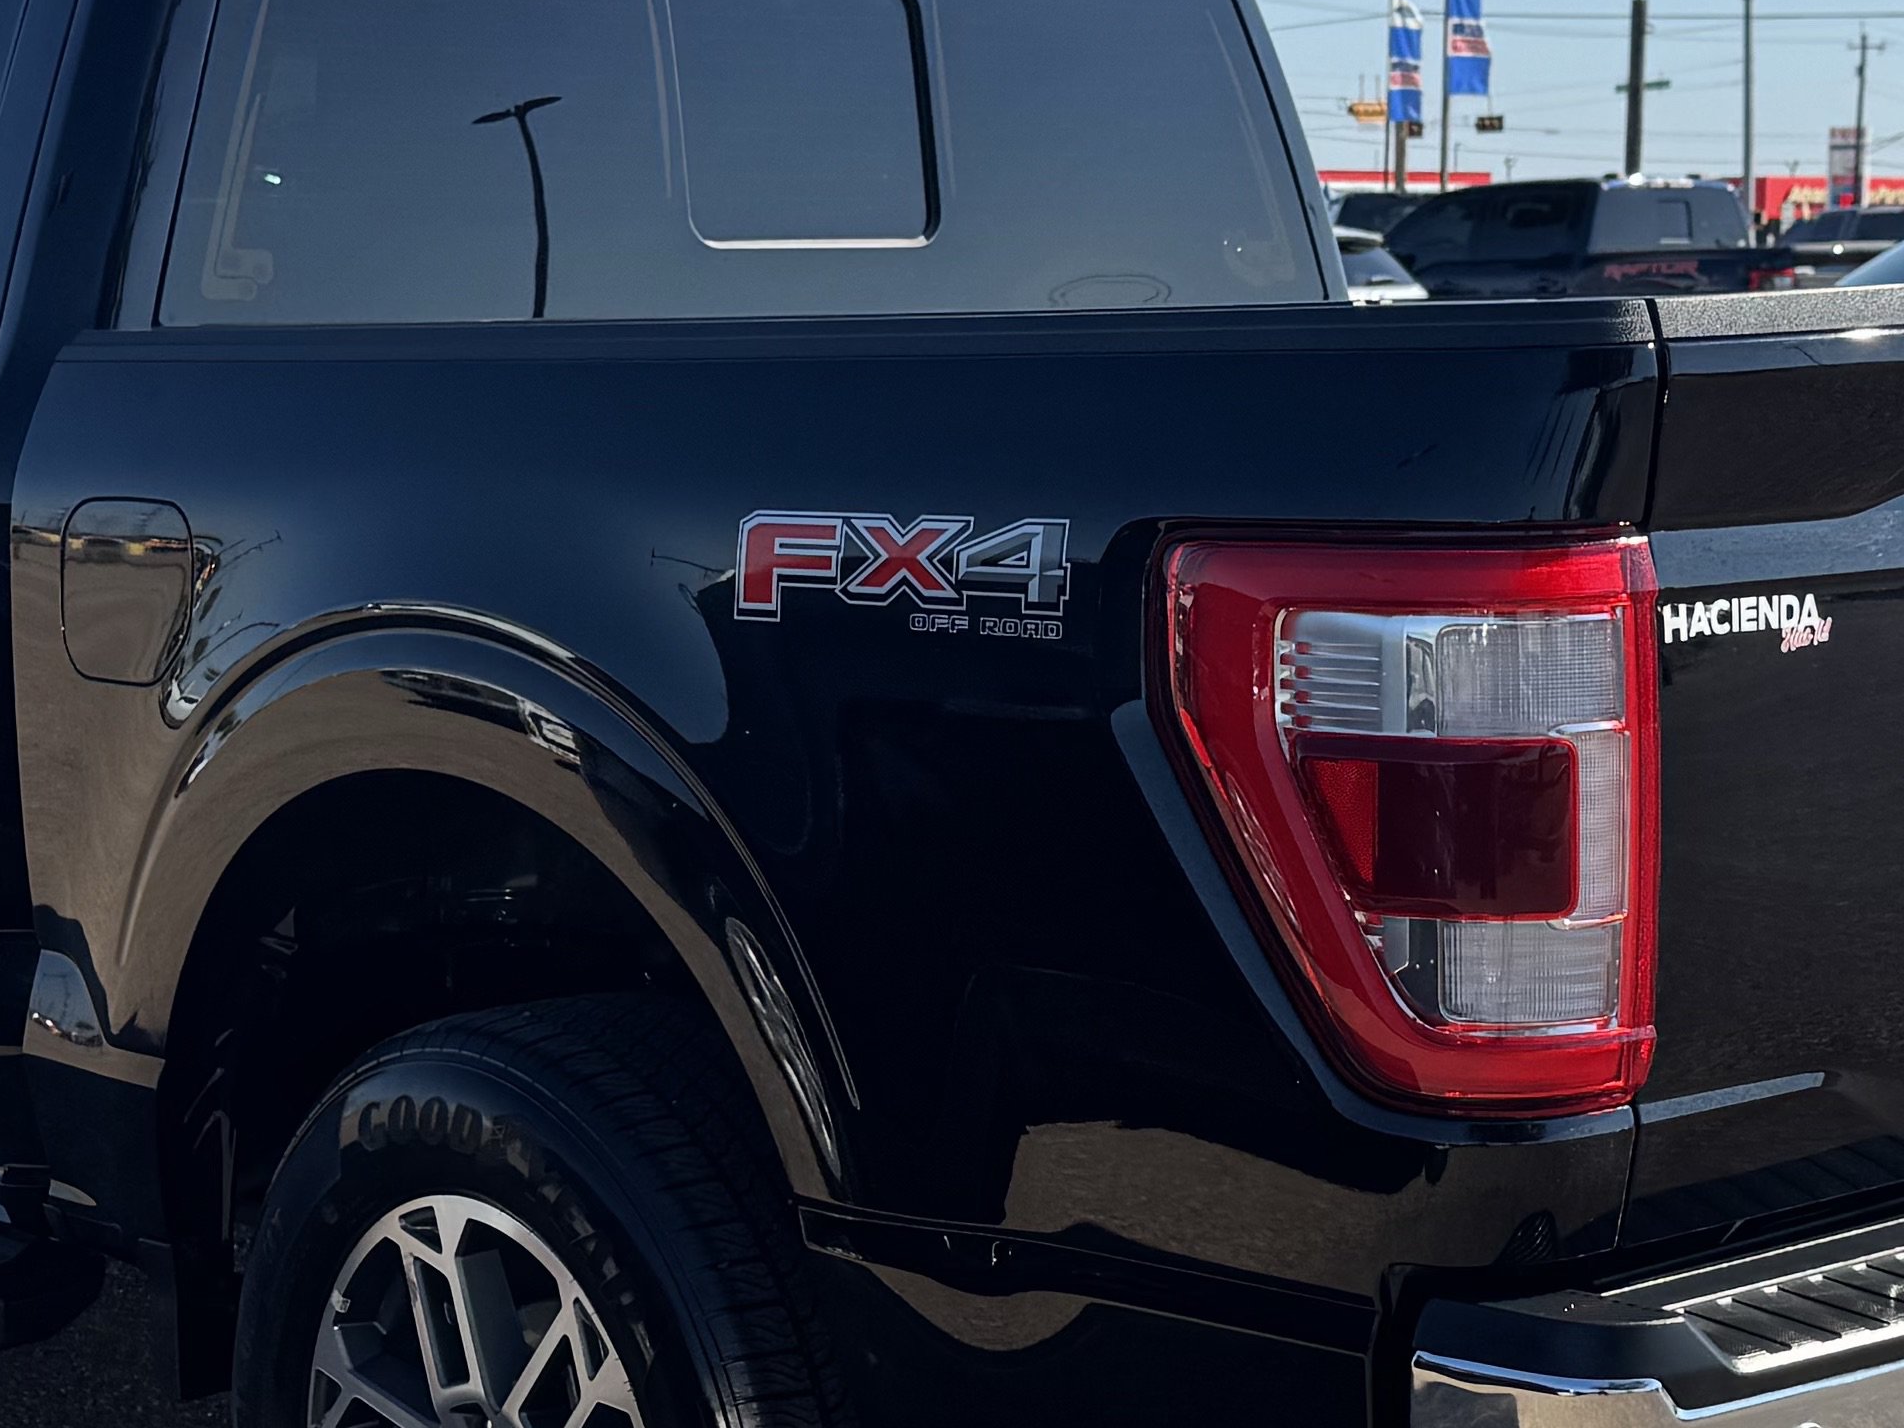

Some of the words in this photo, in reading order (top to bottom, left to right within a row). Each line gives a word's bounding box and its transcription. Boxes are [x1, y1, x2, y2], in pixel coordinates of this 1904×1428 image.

[734, 510, 1070, 621] FX4
[910, 613, 969, 632] OFF
[979, 617, 1063, 639] ROAD
[1661, 593, 1821, 644] HACIENDA
